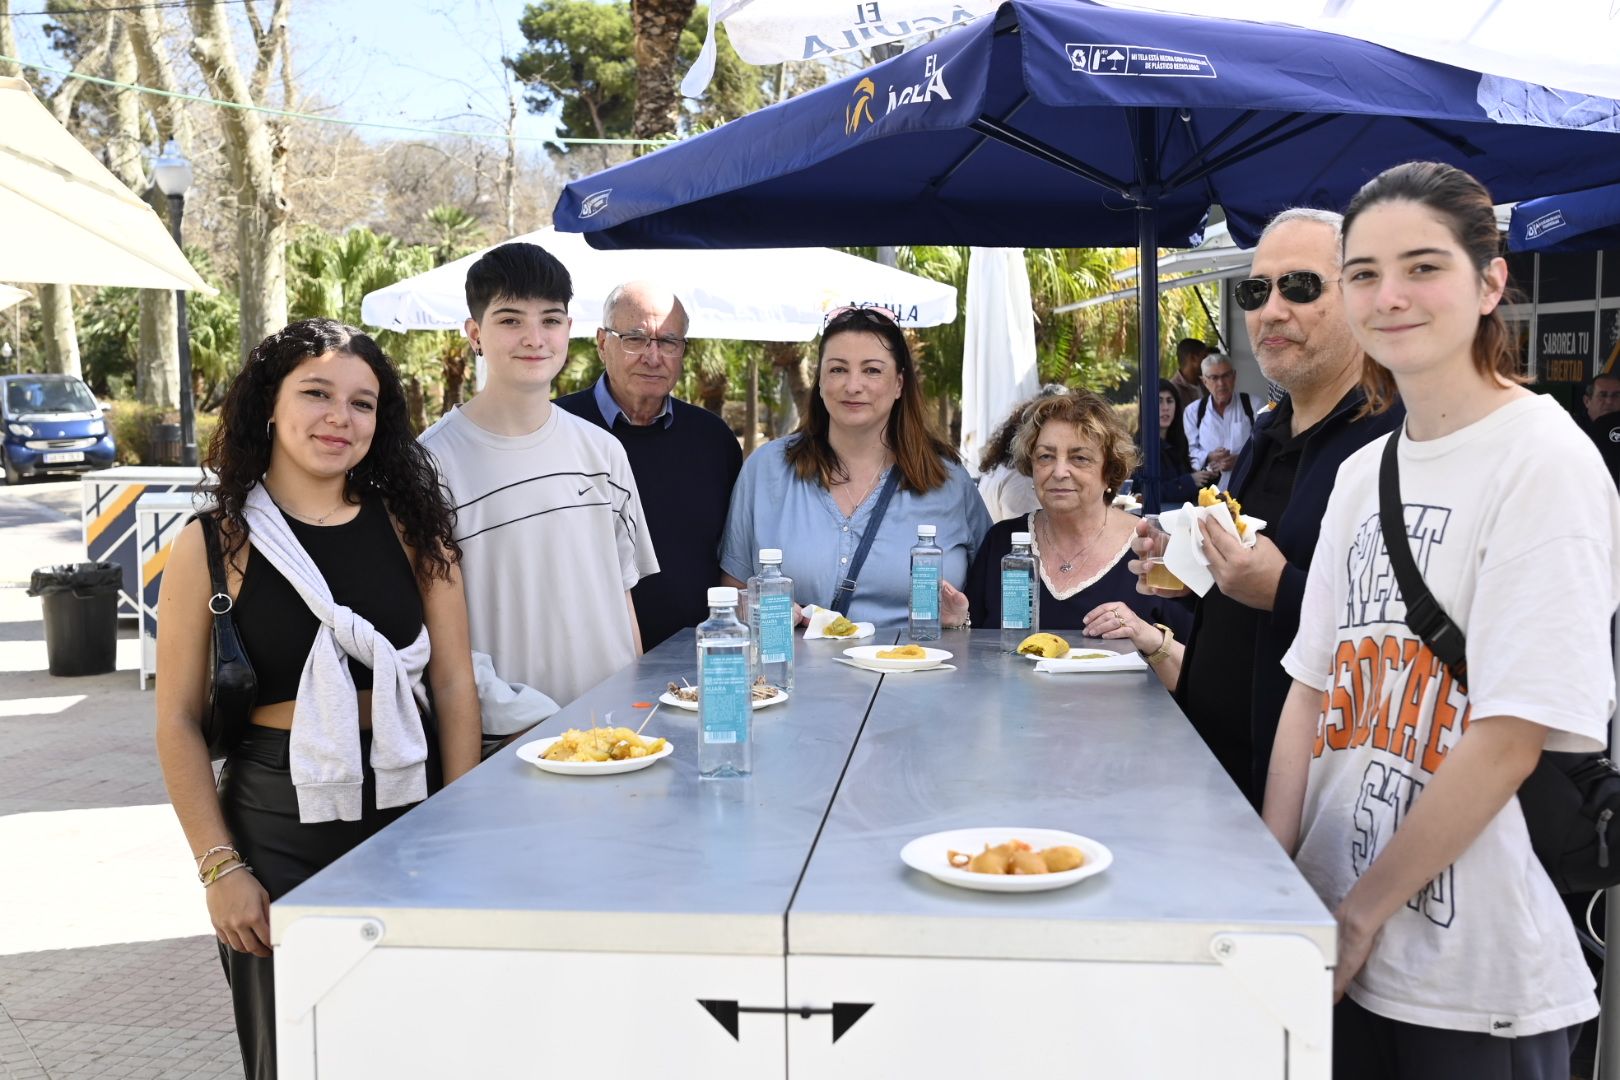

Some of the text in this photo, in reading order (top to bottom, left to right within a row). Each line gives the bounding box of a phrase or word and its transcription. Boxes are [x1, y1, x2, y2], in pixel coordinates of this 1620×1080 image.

[925, 54, 938, 78] EL
[1151, 61, 1173, 70] PLÁSTICO
[1542, 331, 1590, 355] SABOREA TU
[1546, 360, 1584, 382] LIBERTAD
